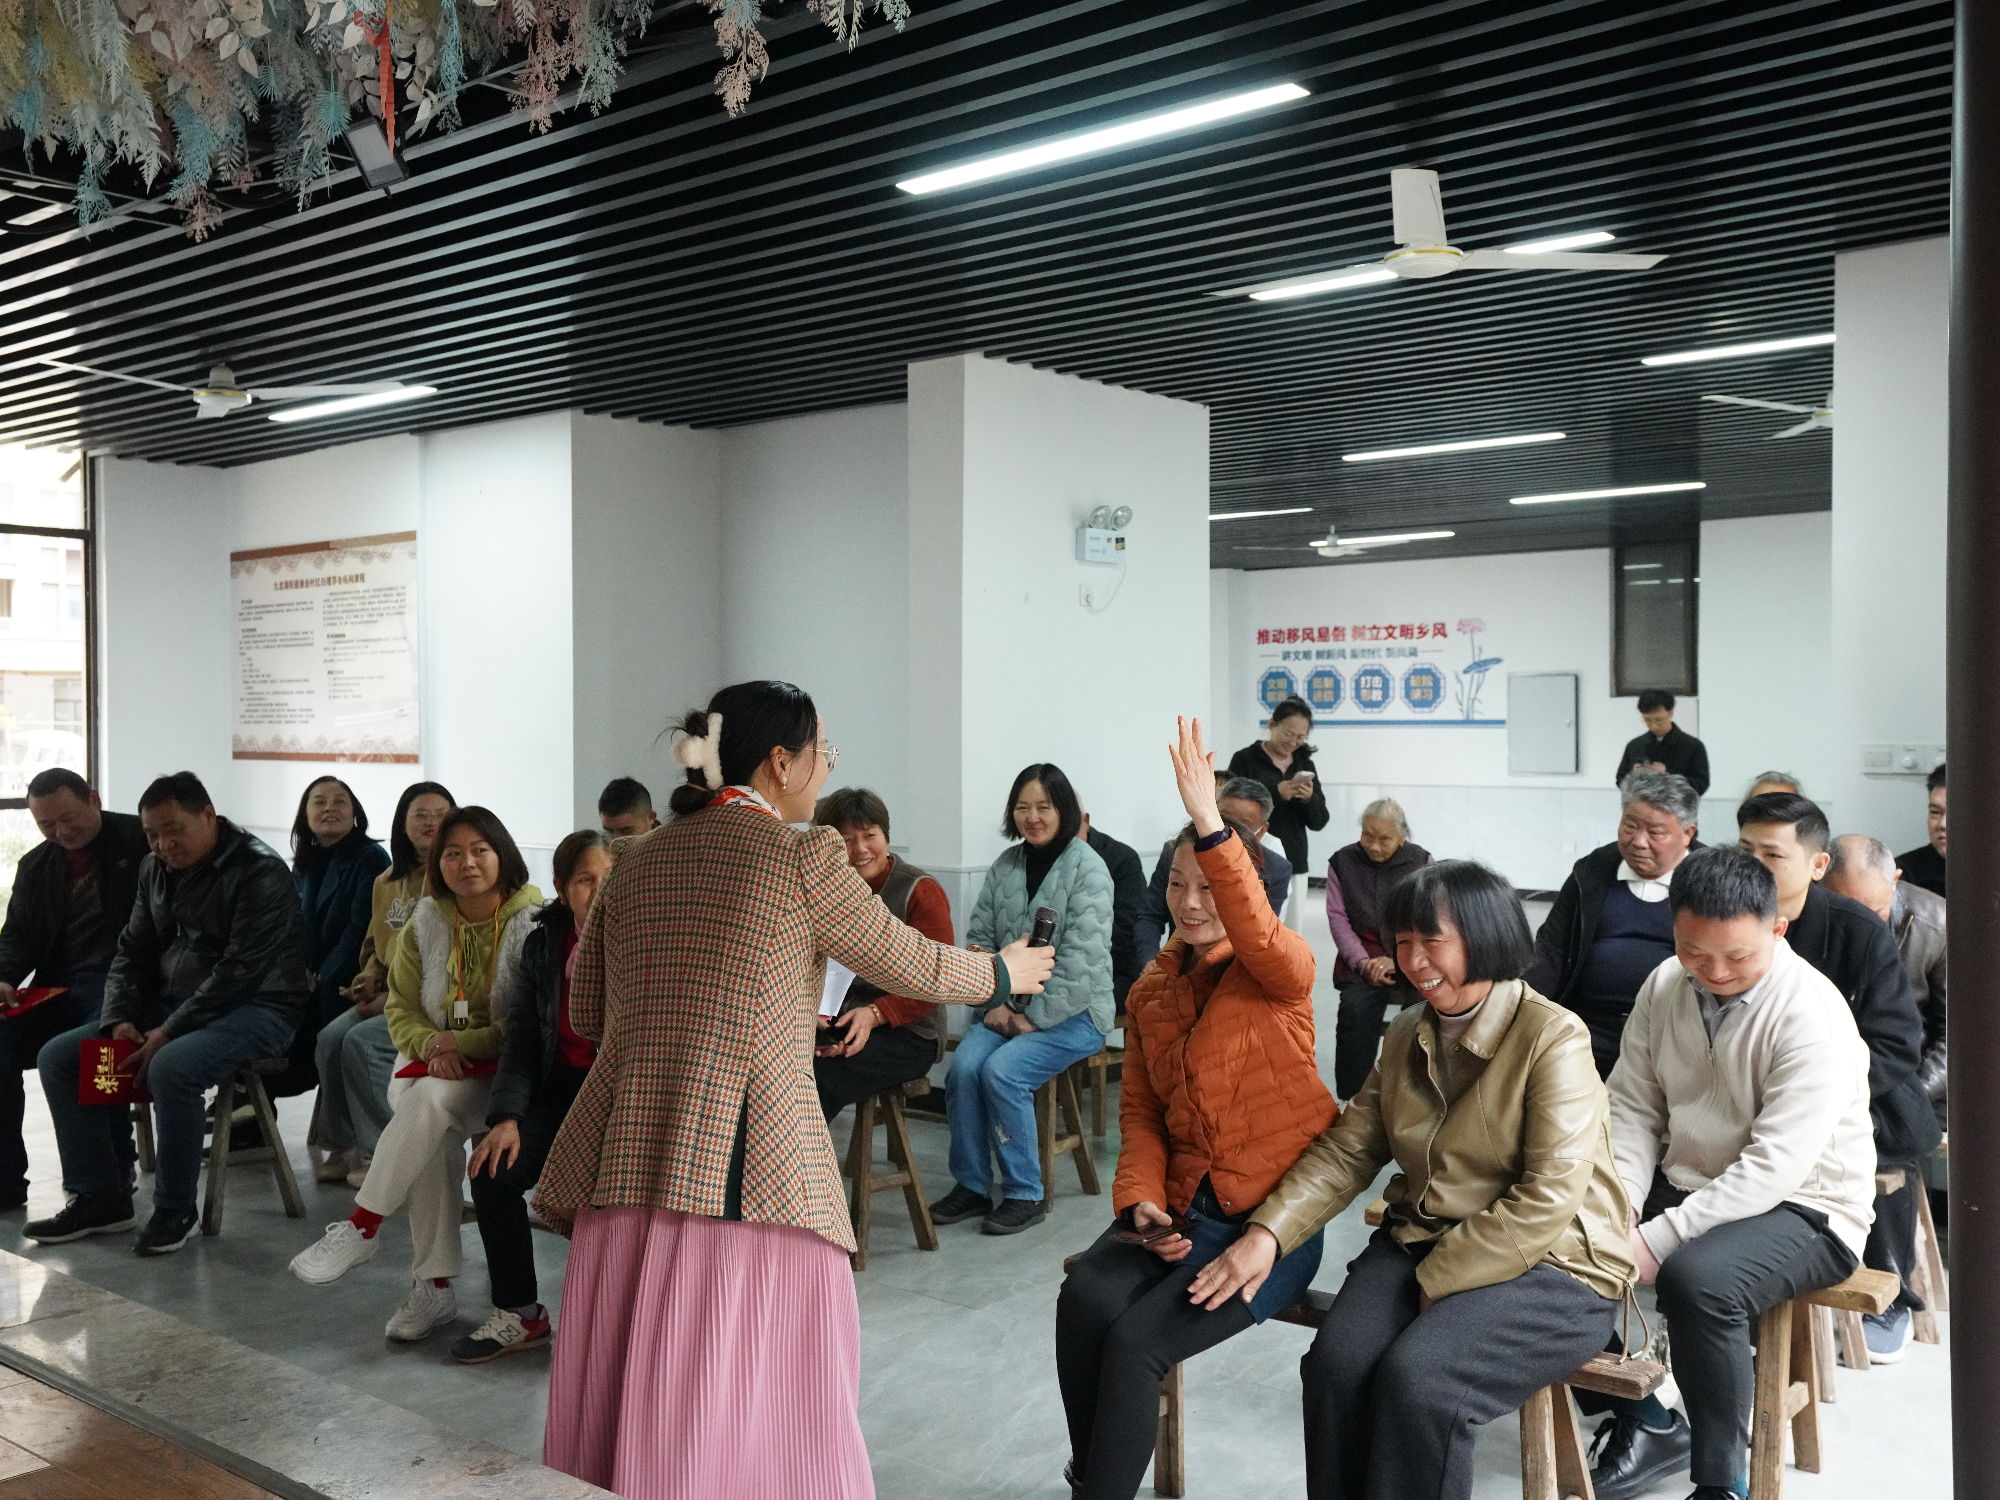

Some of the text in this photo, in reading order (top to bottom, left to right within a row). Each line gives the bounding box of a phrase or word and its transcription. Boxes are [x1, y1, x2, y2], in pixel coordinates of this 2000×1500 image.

[1257, 622, 1448, 645] 推动移风易俗 树立文明乡风
